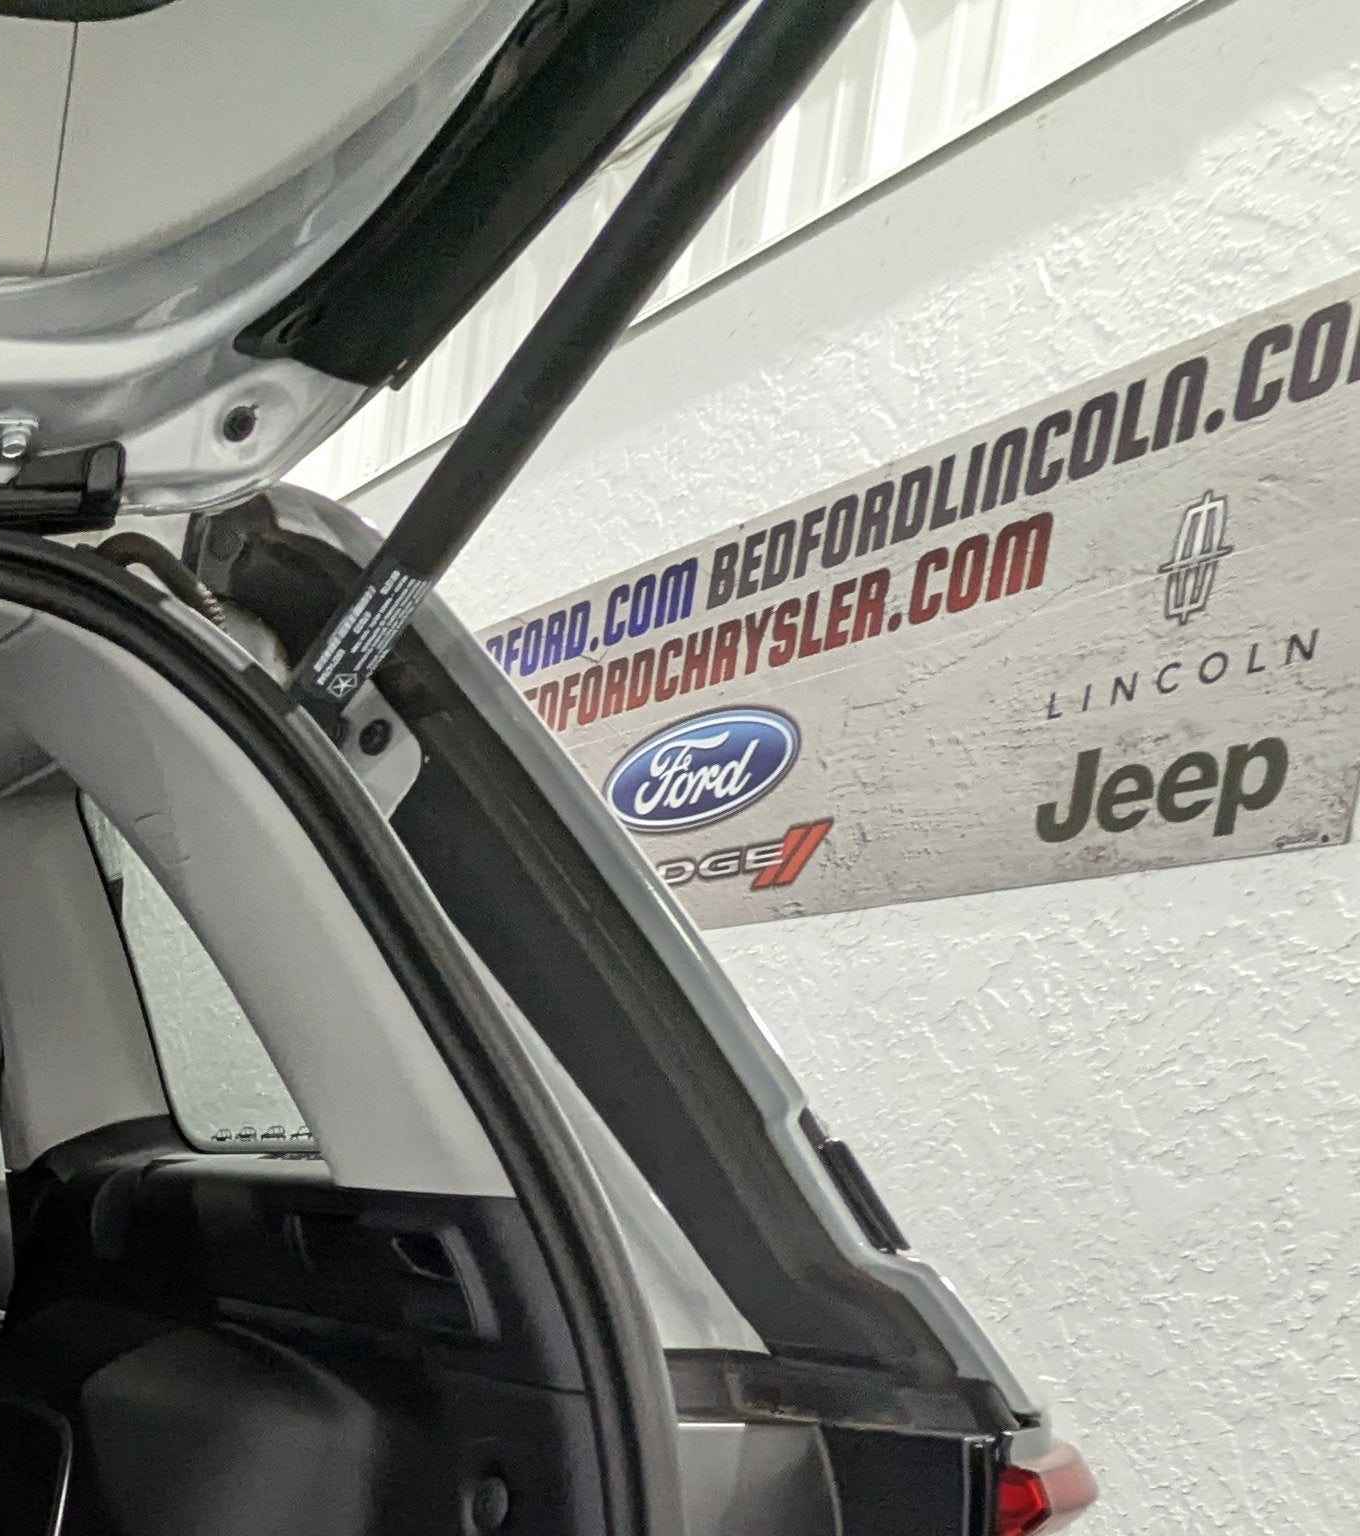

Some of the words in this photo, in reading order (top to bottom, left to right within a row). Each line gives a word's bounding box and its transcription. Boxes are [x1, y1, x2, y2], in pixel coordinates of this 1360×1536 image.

[706, 300, 1360, 610] BEDFORDLINCOLN.CO
[523, 511, 1054, 732] DFORDCHRYSLER.COM
[1047, 628, 1320, 720] LINCOLN
[634, 730, 760, 816] Ford
[1036, 737, 1289, 843] Jeep
